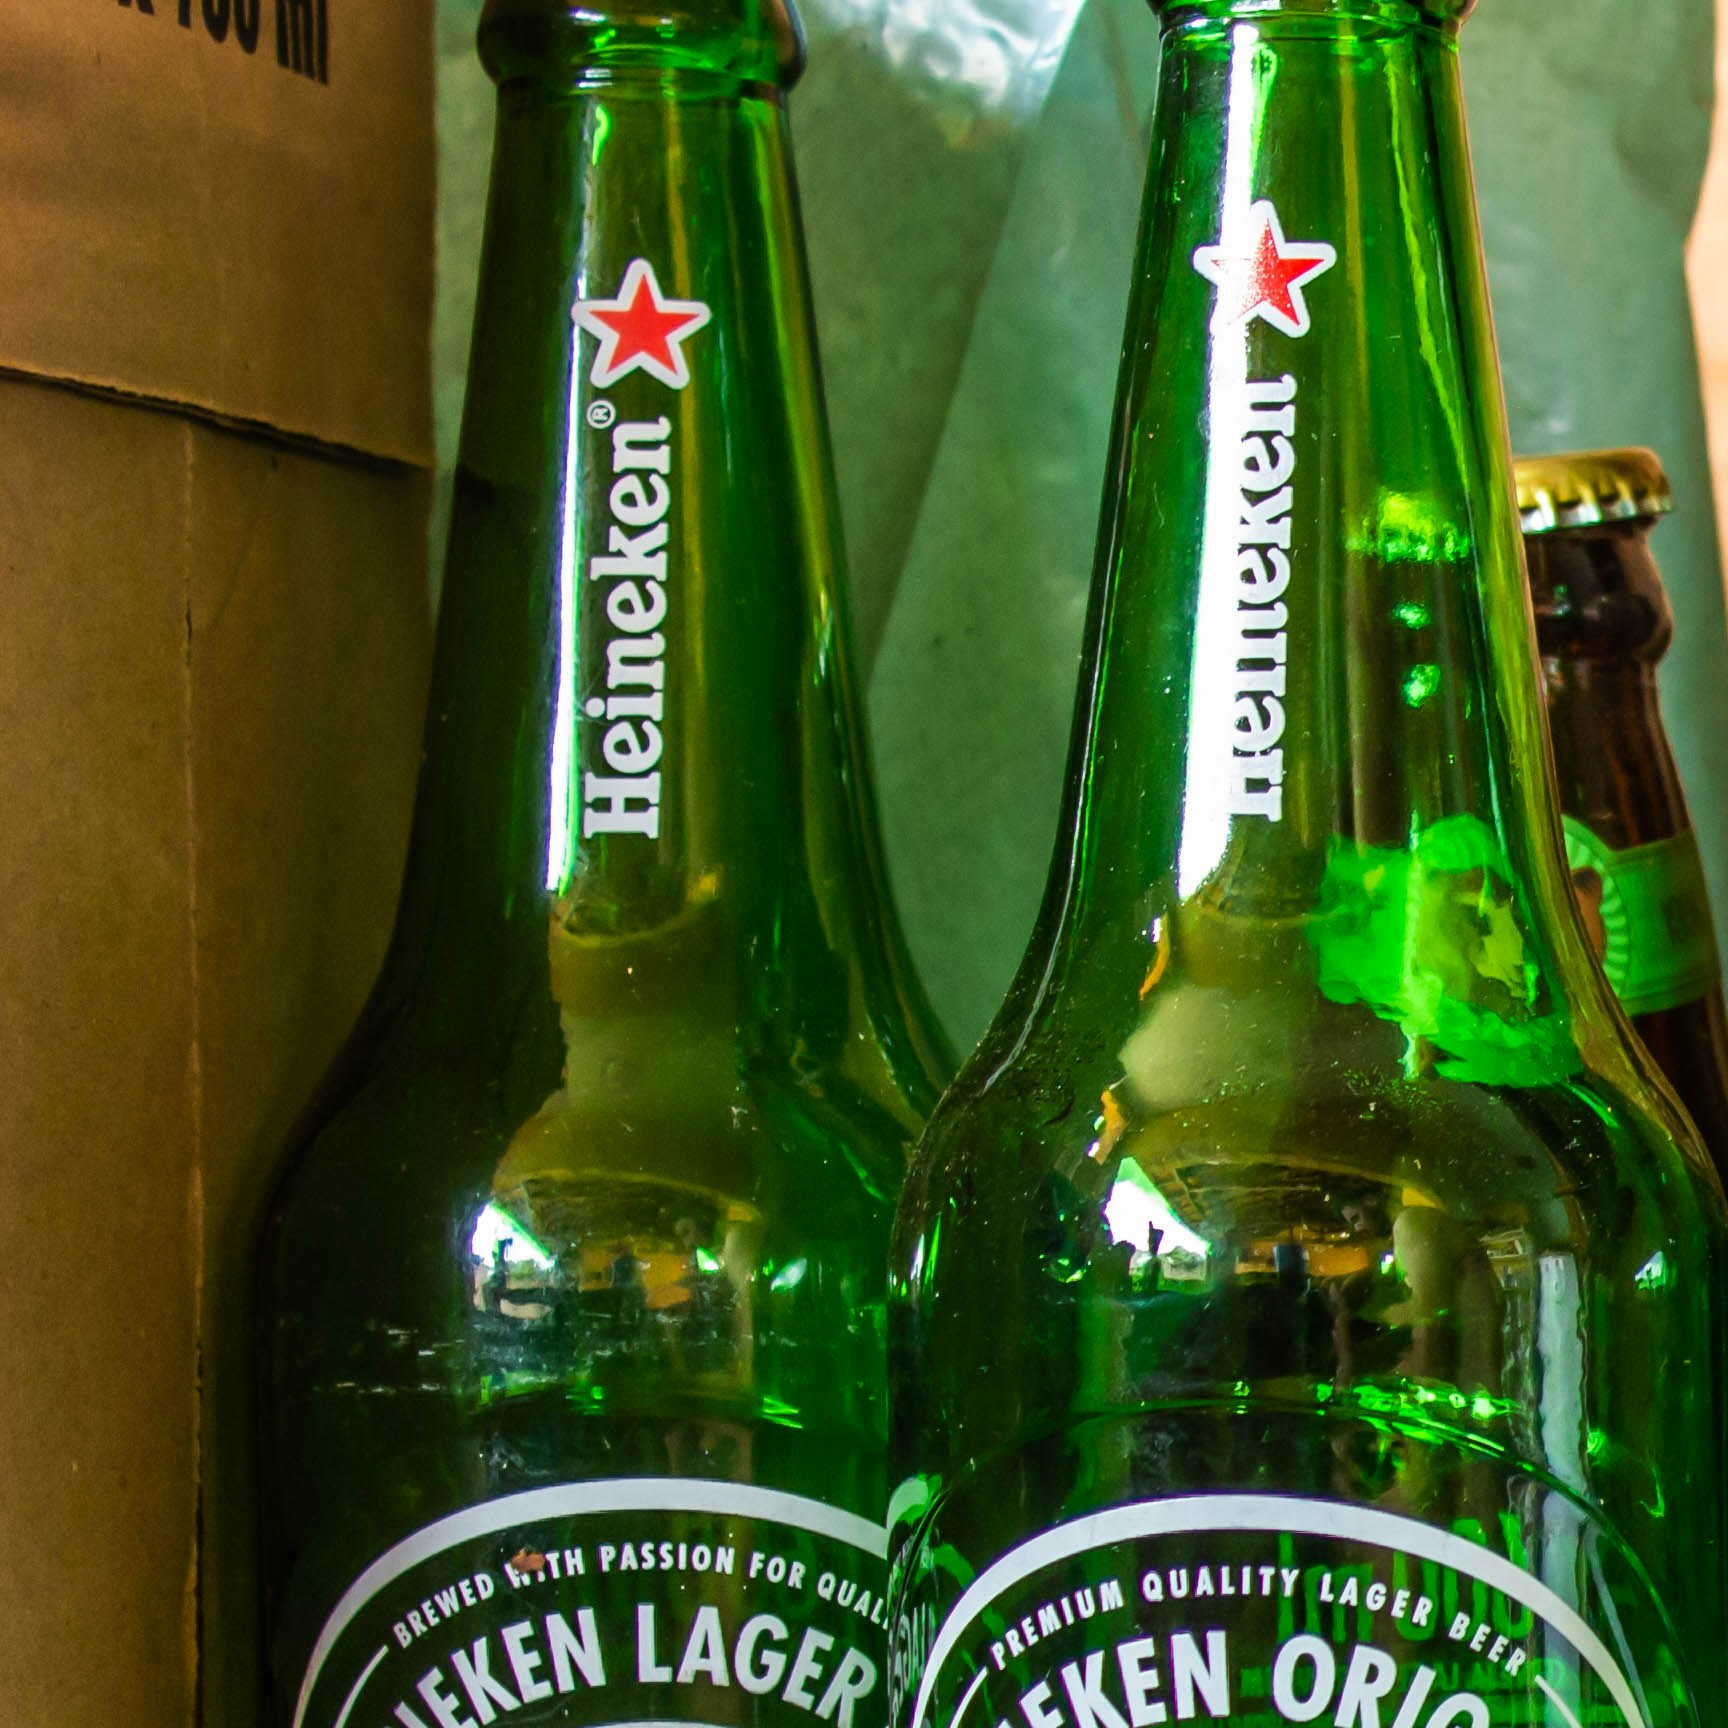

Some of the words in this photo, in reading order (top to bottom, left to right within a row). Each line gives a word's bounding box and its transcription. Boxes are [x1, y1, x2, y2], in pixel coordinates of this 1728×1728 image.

[582, 416, 673, 840] Heineken
[393, 1575, 493, 1648] BREWED
[600, 1543, 735, 1574] PASSION
[749, 1553, 805, 1588] FOR
[992, 1581, 1123, 1669] PREMIUM
[1142, 1566, 1299, 1601] QUALITY
[1320, 1574, 1431, 1626] LAGER
[1449, 1612, 1526, 1676] BEER
